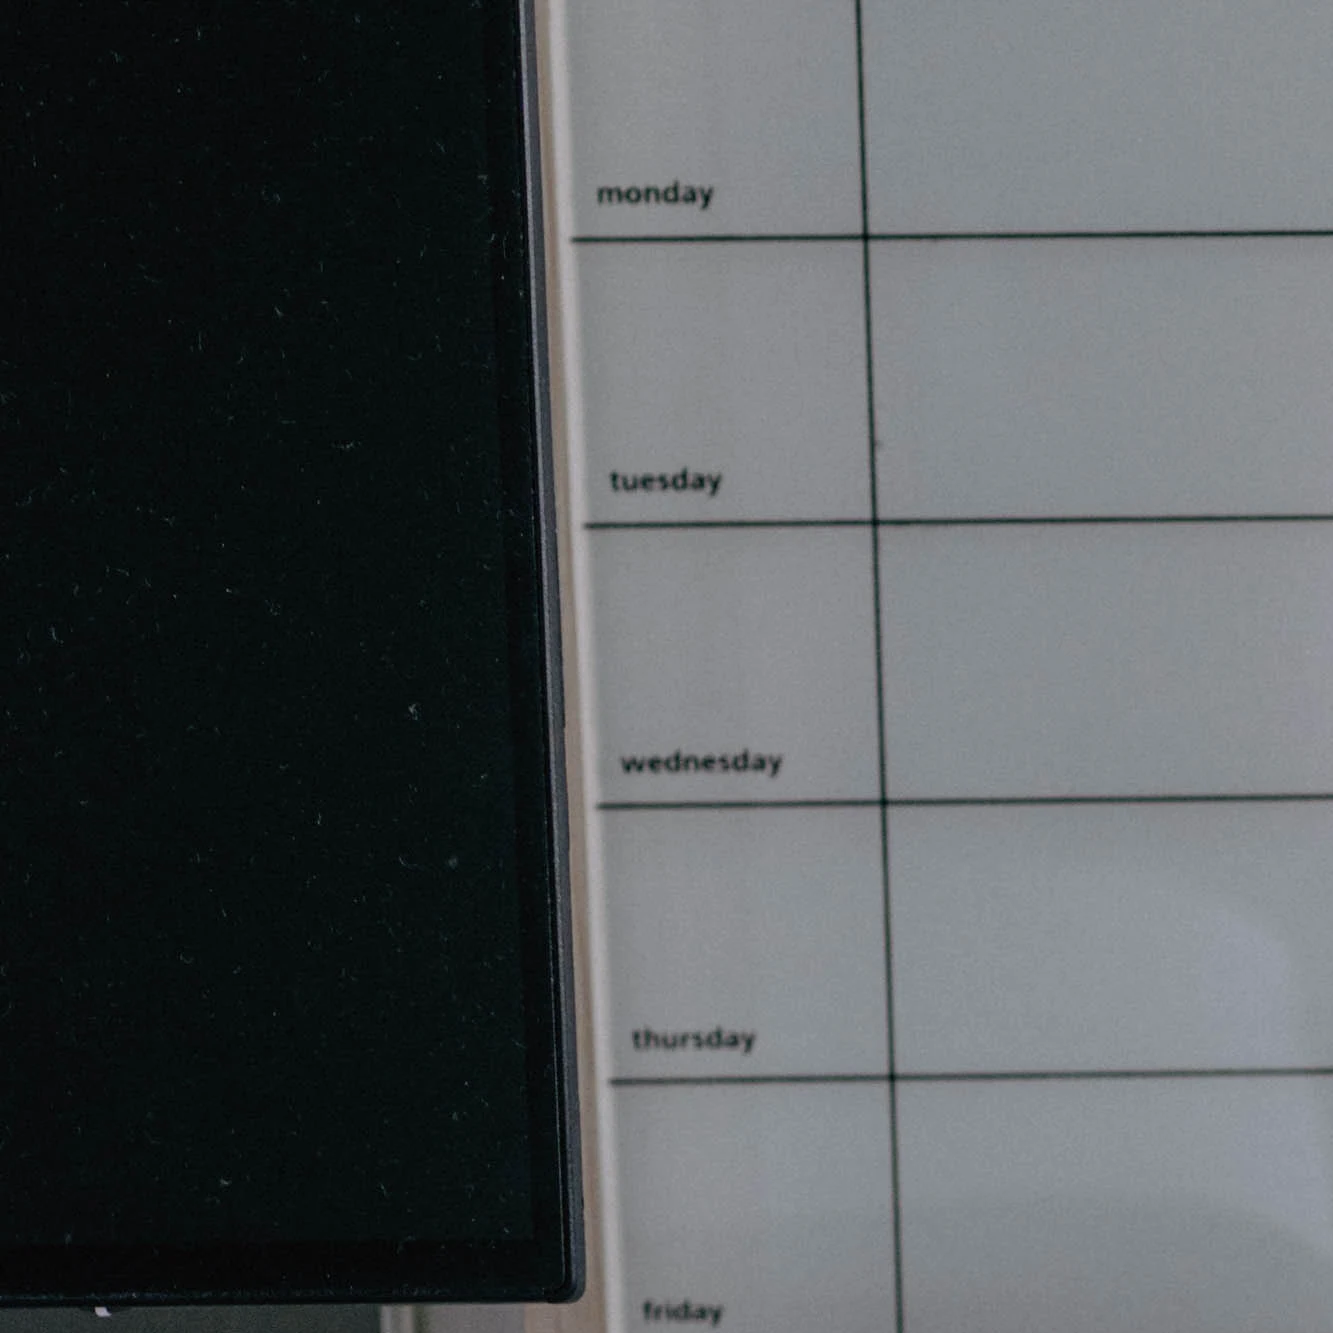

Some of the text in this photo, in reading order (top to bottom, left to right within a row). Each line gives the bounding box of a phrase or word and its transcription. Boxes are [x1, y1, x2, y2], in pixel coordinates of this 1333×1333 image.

[597, 179, 714, 210] monday
[609, 466, 723, 497] tuesday
[621, 749, 784, 778] wednesday
[631, 1026, 756, 1054] thursday
[643, 1299, 724, 1327] friday
